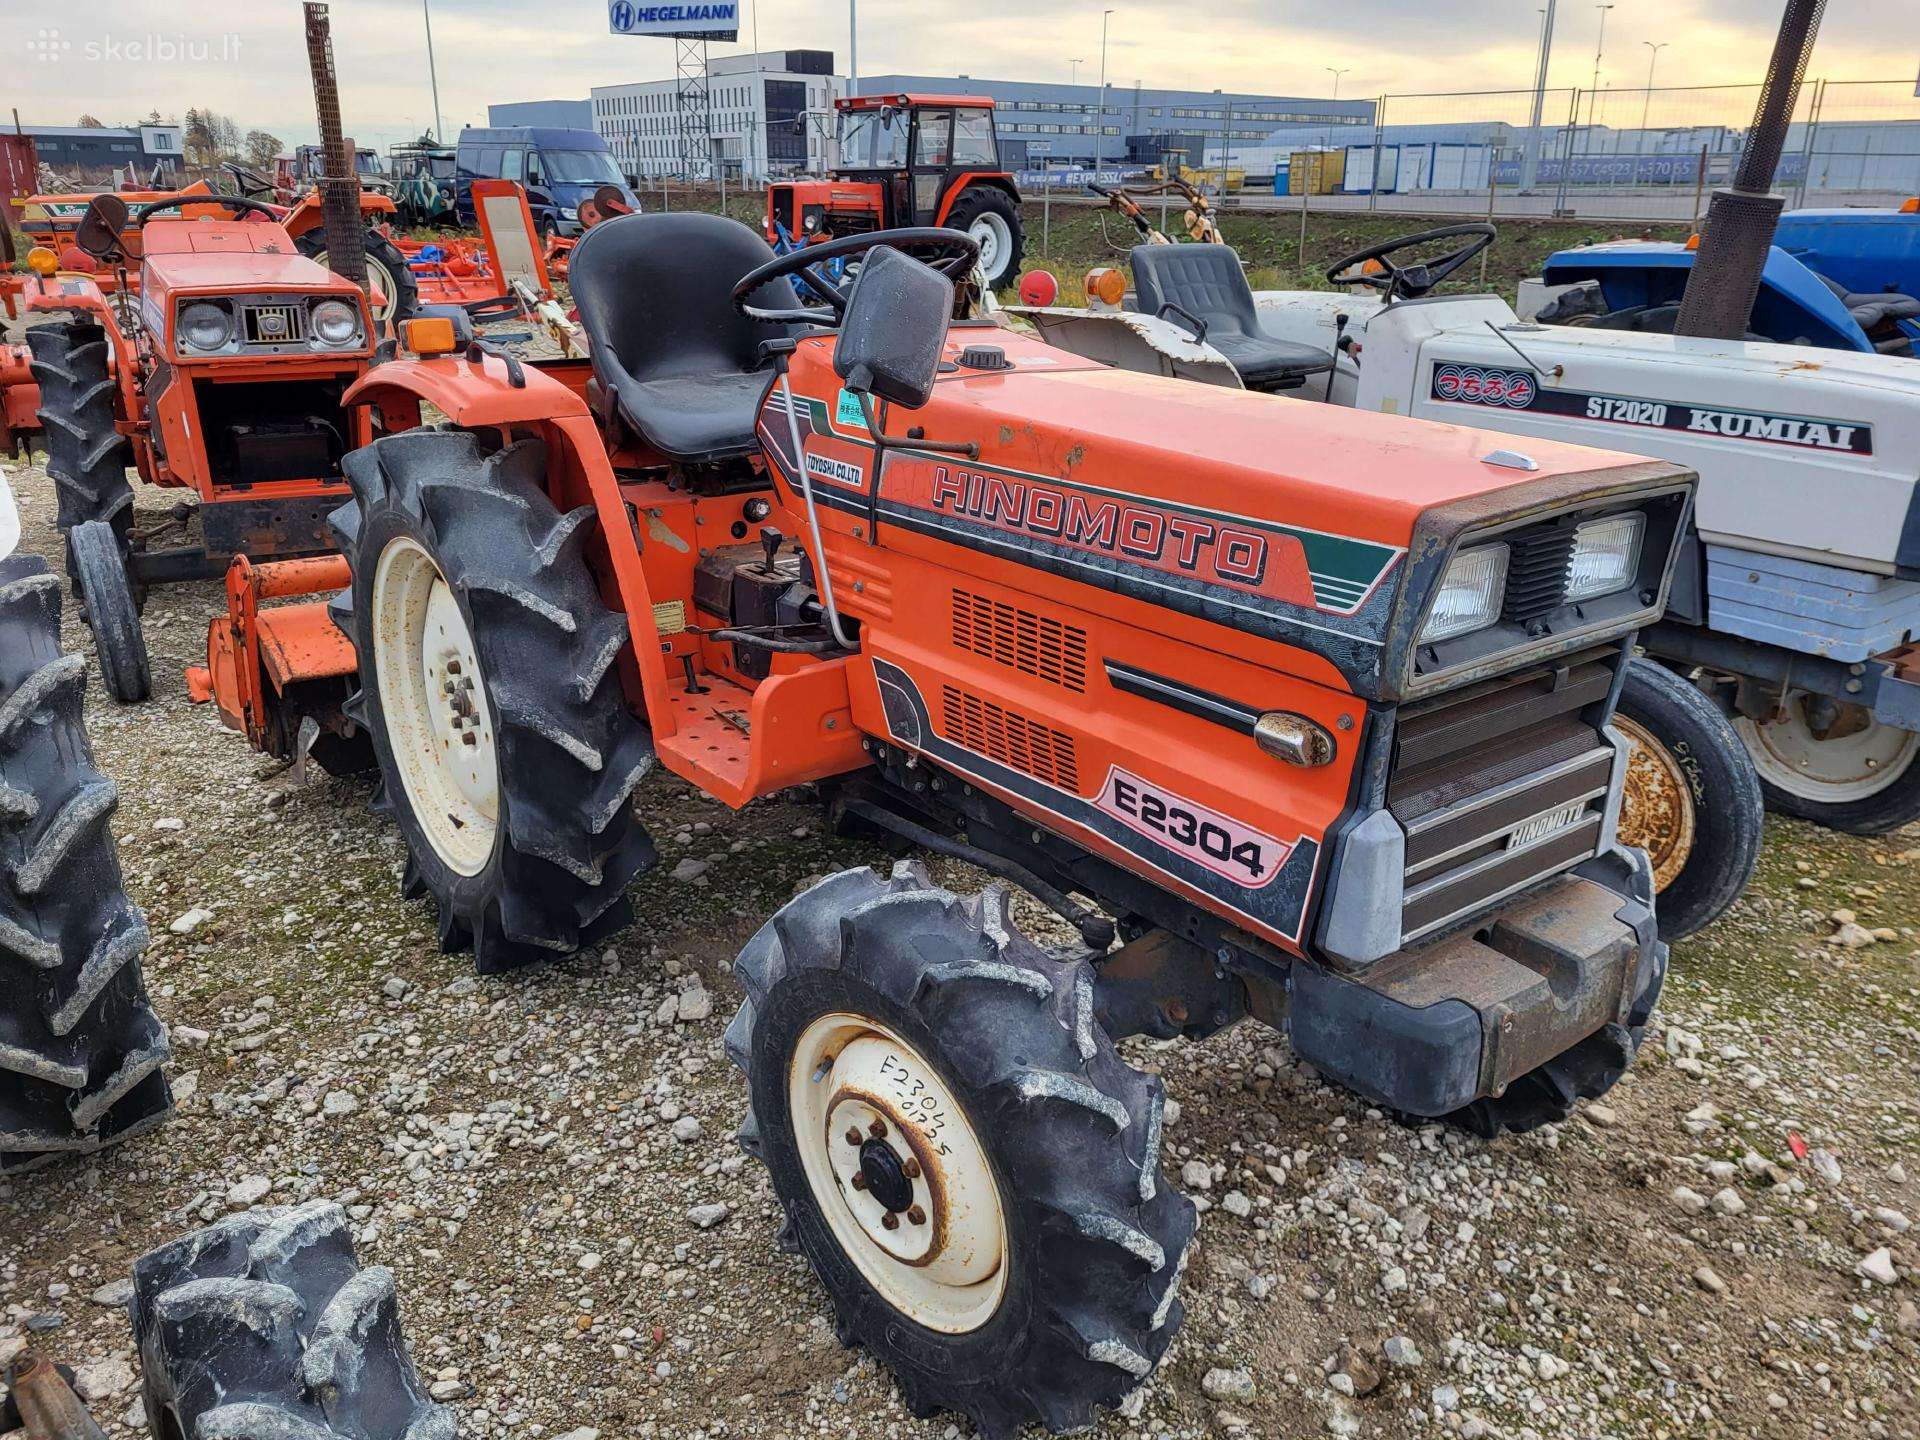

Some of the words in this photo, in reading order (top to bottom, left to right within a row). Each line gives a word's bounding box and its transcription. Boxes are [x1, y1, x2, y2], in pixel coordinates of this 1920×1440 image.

[638, 4, 735, 22] HEGELMANN
[1586, 396, 1668, 427] ST2020
[1687, 409, 1856, 450] KUMIAI
[807, 454, 835, 476] TOYOSHA
[932, 466, 1269, 587] HINOMOTO
[1114, 778, 1265, 878] E2304
[1508, 801, 1586, 849] HINOMOTO
[879, 1055, 946, 1129] E2304
